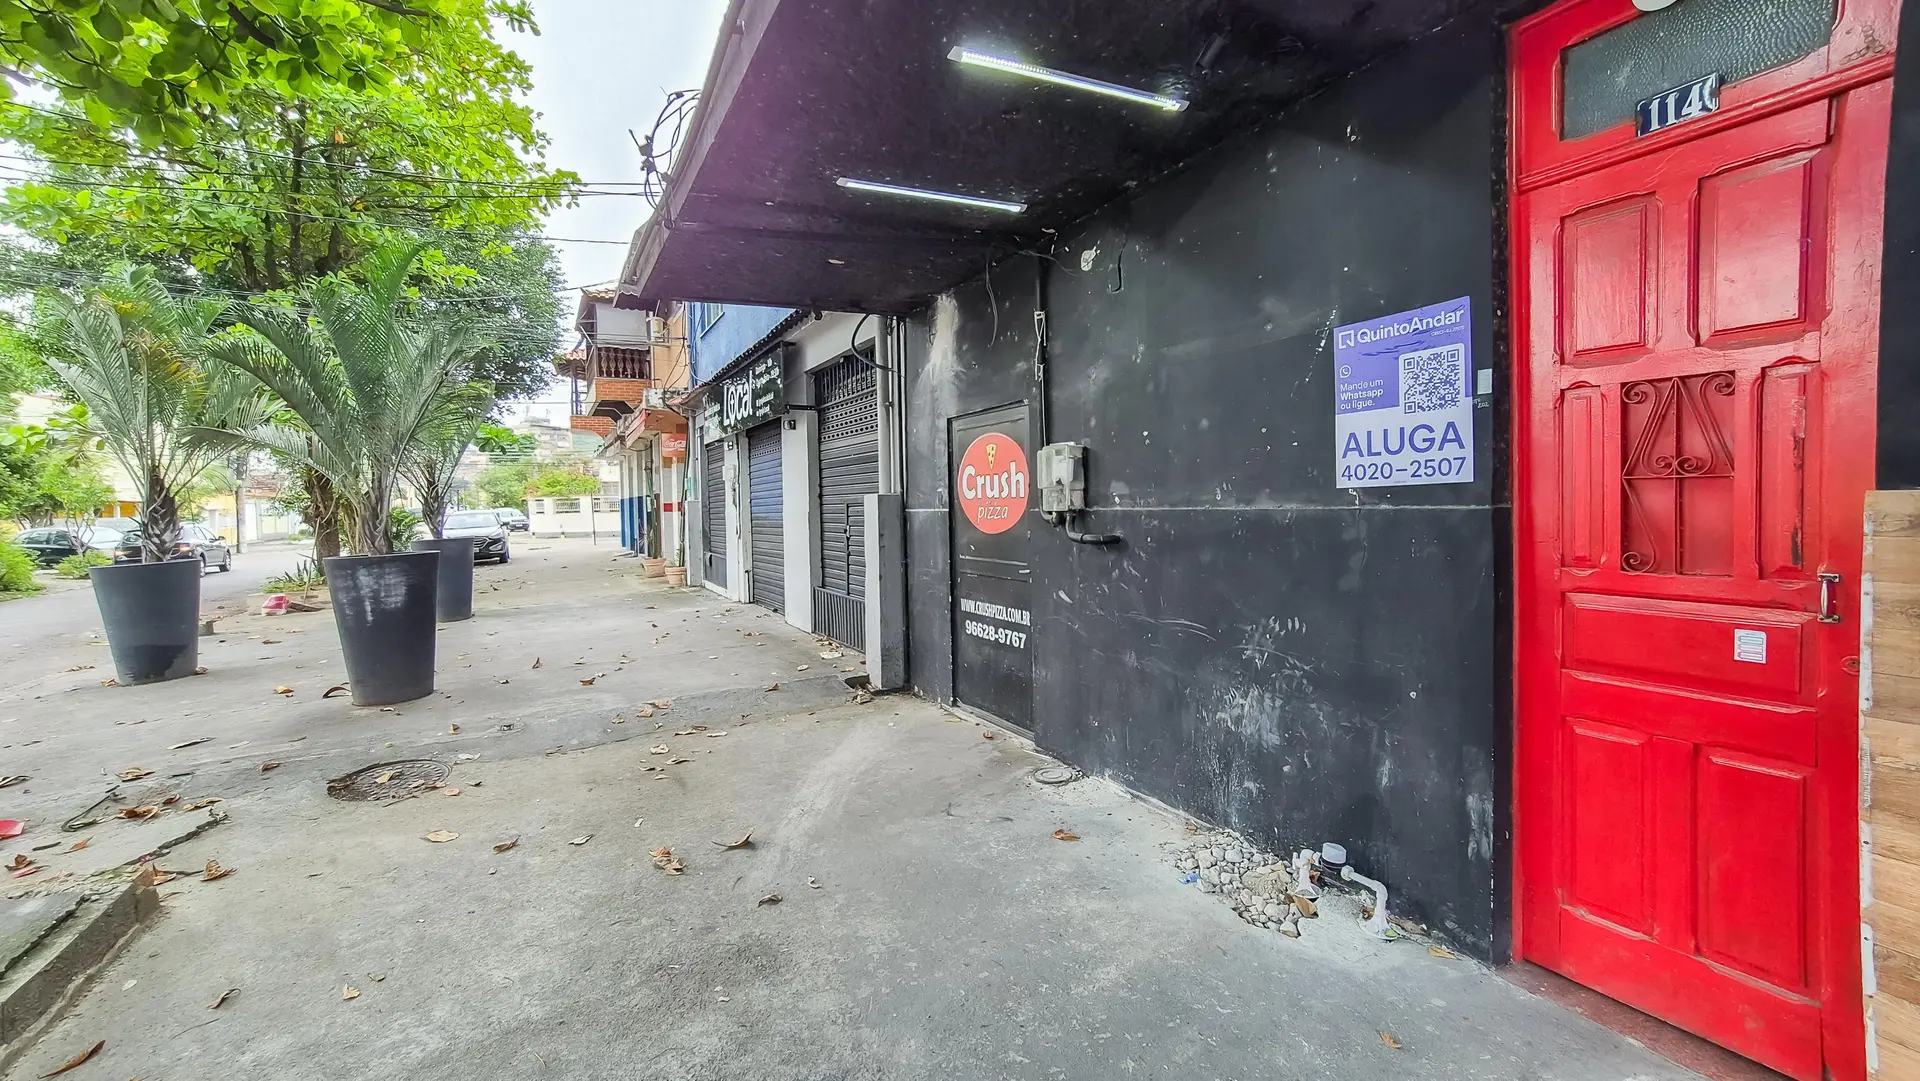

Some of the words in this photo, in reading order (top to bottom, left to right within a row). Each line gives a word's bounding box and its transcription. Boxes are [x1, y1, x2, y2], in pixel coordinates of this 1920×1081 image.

[1357, 310, 1464, 343] QuintoAndar
[723, 370, 753, 427] Local
[1340, 381, 1369, 392] Mande
[1369, 379, 1384, 388] um
[1340, 387, 1384, 401] Whatsapp
[1340, 402, 1351, 410] ou
[1352, 398, 1376, 410] ligue.
[1342, 421, 1466, 459] ALUGA
[962, 461, 1025, 500] Crush
[1341, 456, 1467, 482] 4020-2507
[977, 501, 1009, 523] pizza
[960, 598, 1031, 626] WWW.CRUSHPIZZA.COM.BR
[965, 619, 1027, 649] 96628-9767
